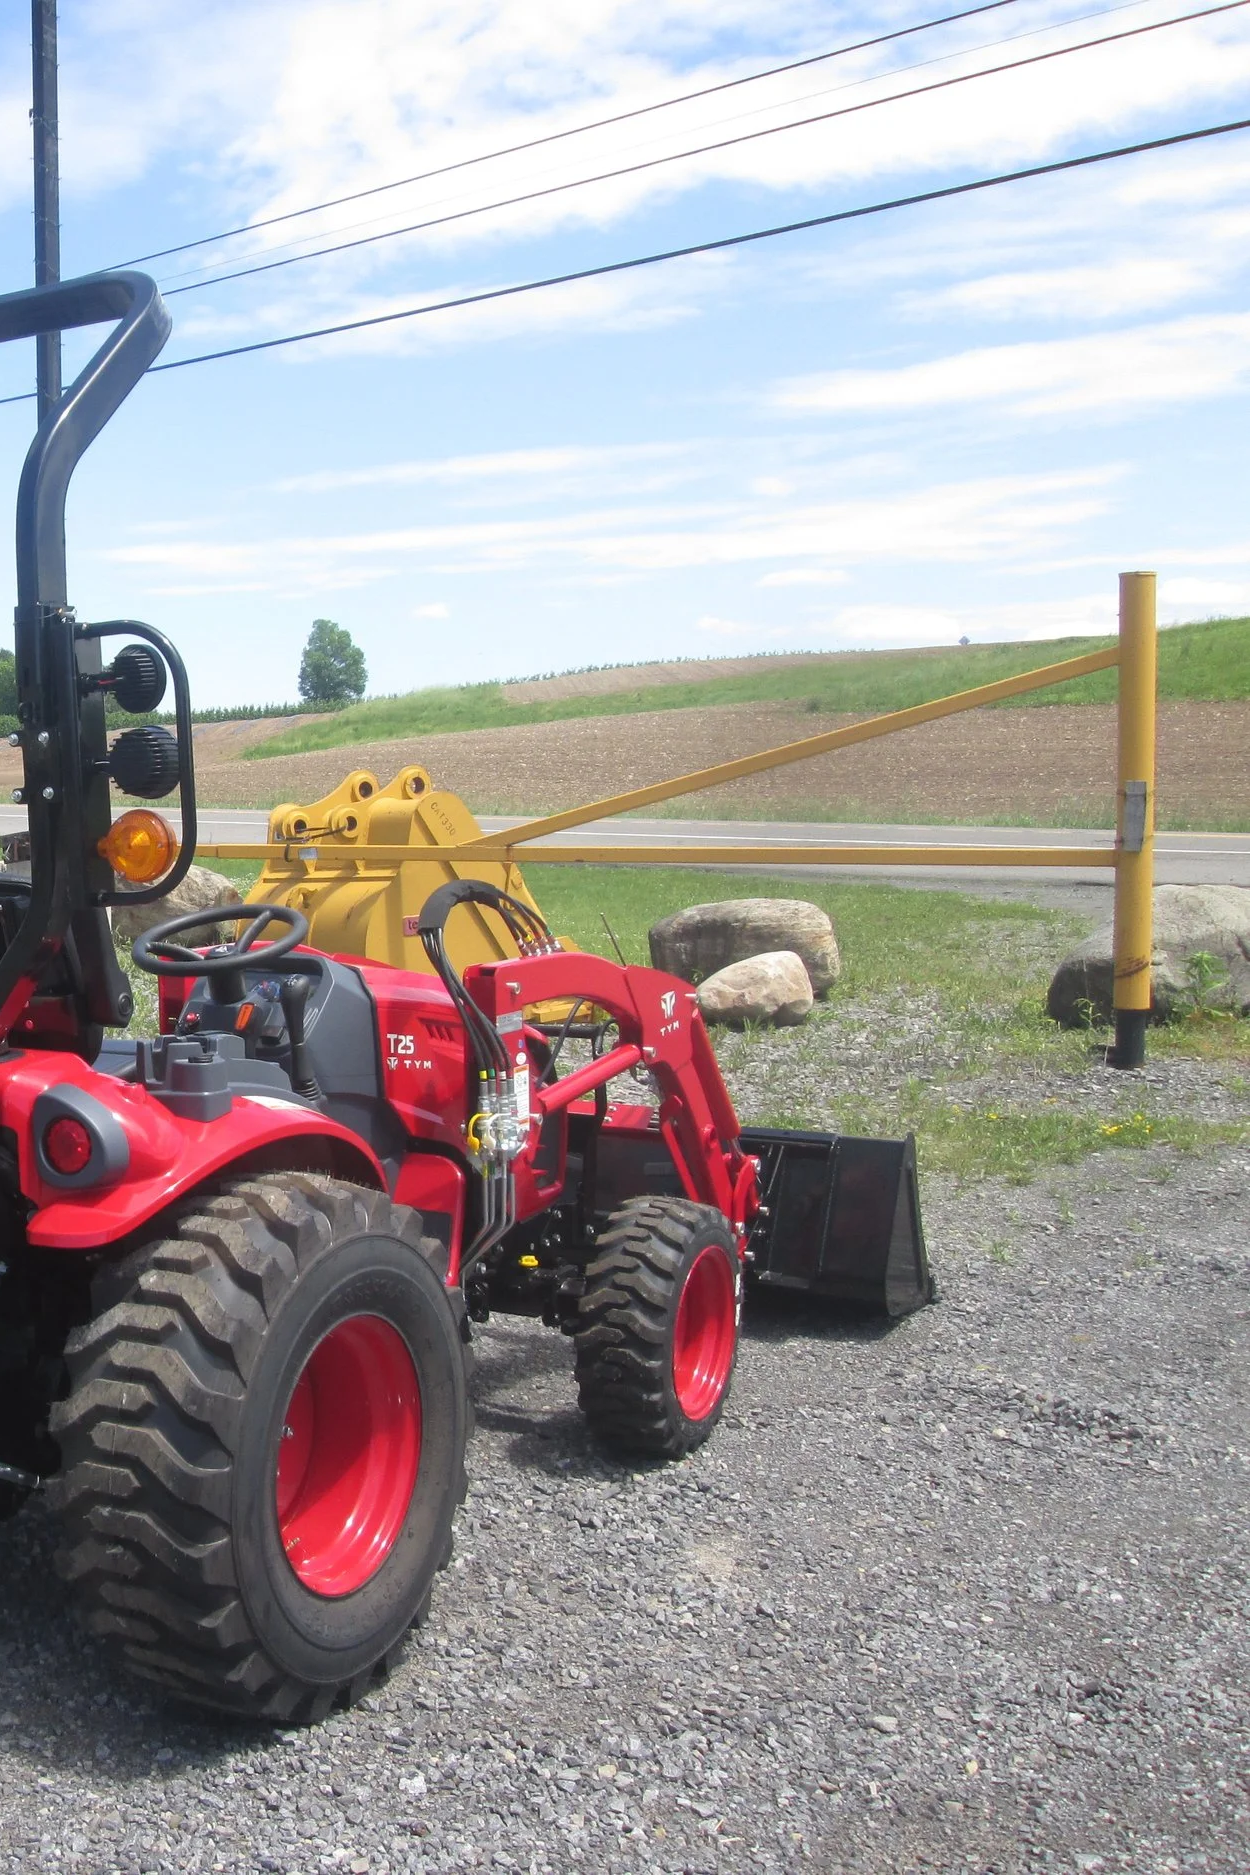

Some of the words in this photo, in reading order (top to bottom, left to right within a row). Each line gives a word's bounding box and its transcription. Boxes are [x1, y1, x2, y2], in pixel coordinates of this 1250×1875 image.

[659, 1021, 680, 1037] TYM
[386, 1033, 415, 1055] T25
[404, 1060, 432, 1070] TYM
